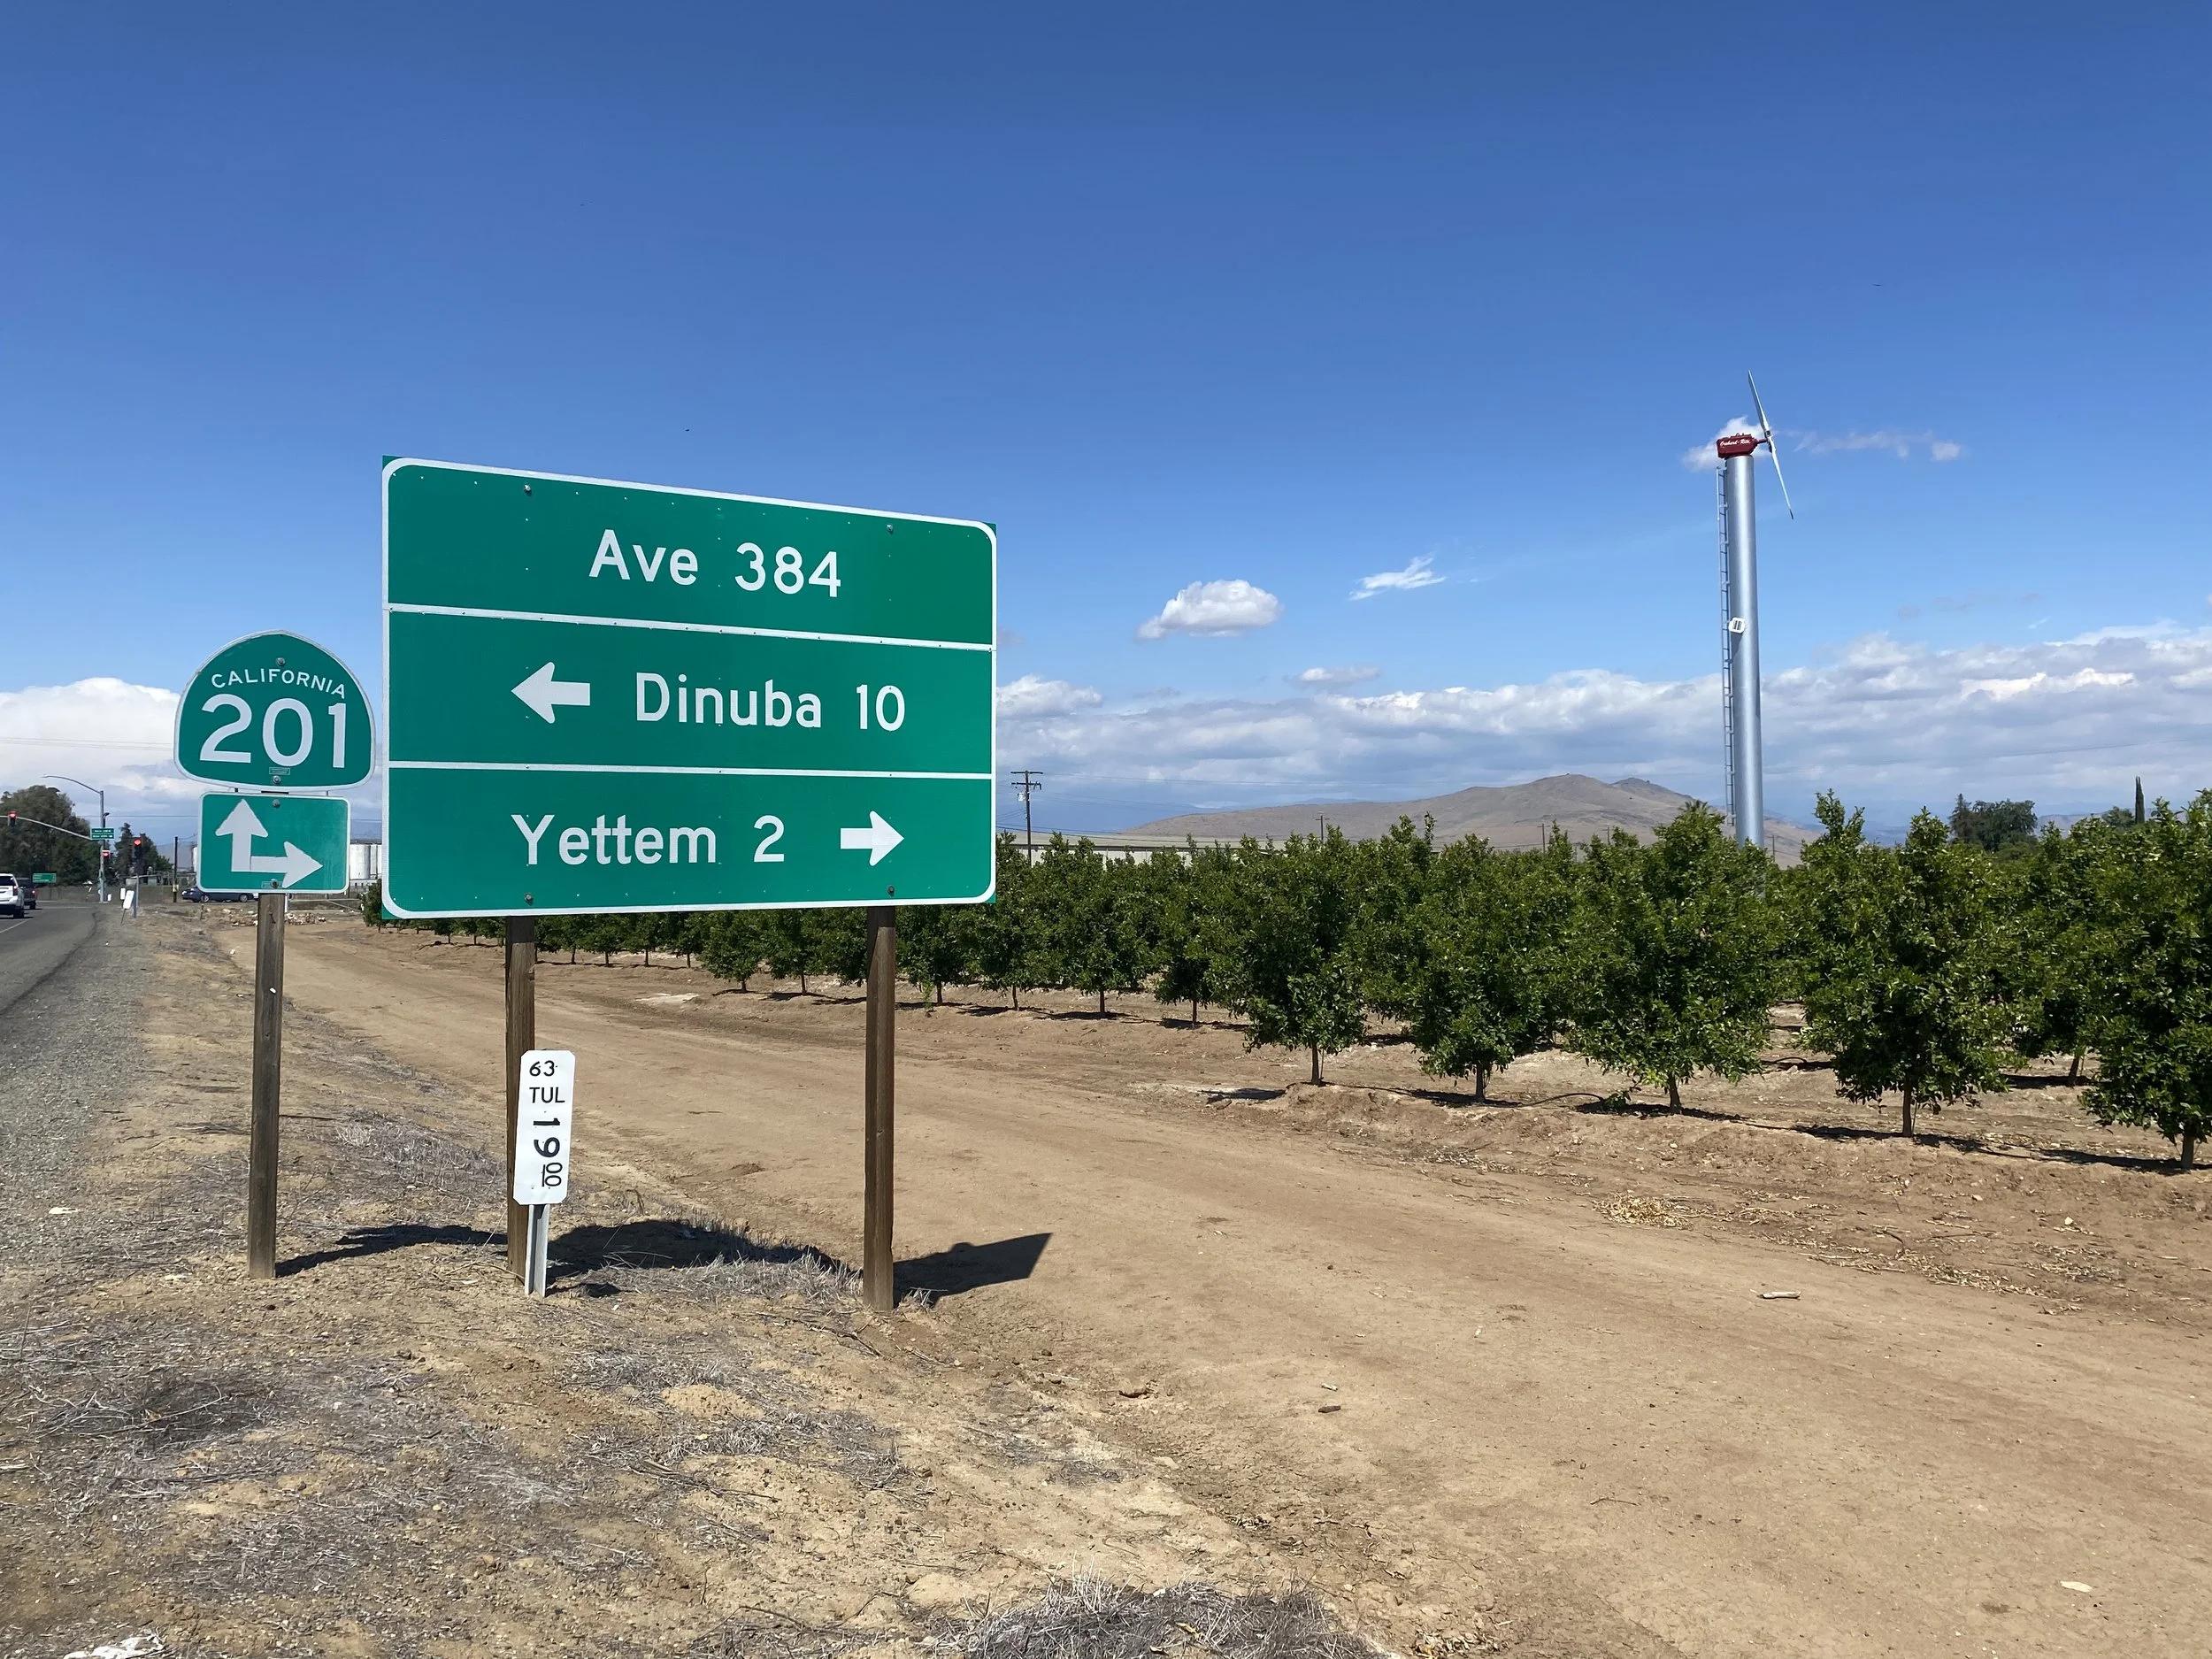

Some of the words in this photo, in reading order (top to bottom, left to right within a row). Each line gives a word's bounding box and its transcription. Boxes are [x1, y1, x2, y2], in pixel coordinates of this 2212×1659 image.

[589, 529, 698, 586] Ave
[734, 542, 841, 598] 384
[211, 668, 345, 699] CALIFORNIA
[636, 672, 821, 728] Dinuba
[856, 684, 905, 732] 10
[199, 693, 347, 769] 201
[511, 815, 717, 865] Yettem
[753, 815, 785, 863] 2
[529, 1060, 555, 1077] 63
[529, 1087, 565, 1103] TUL
